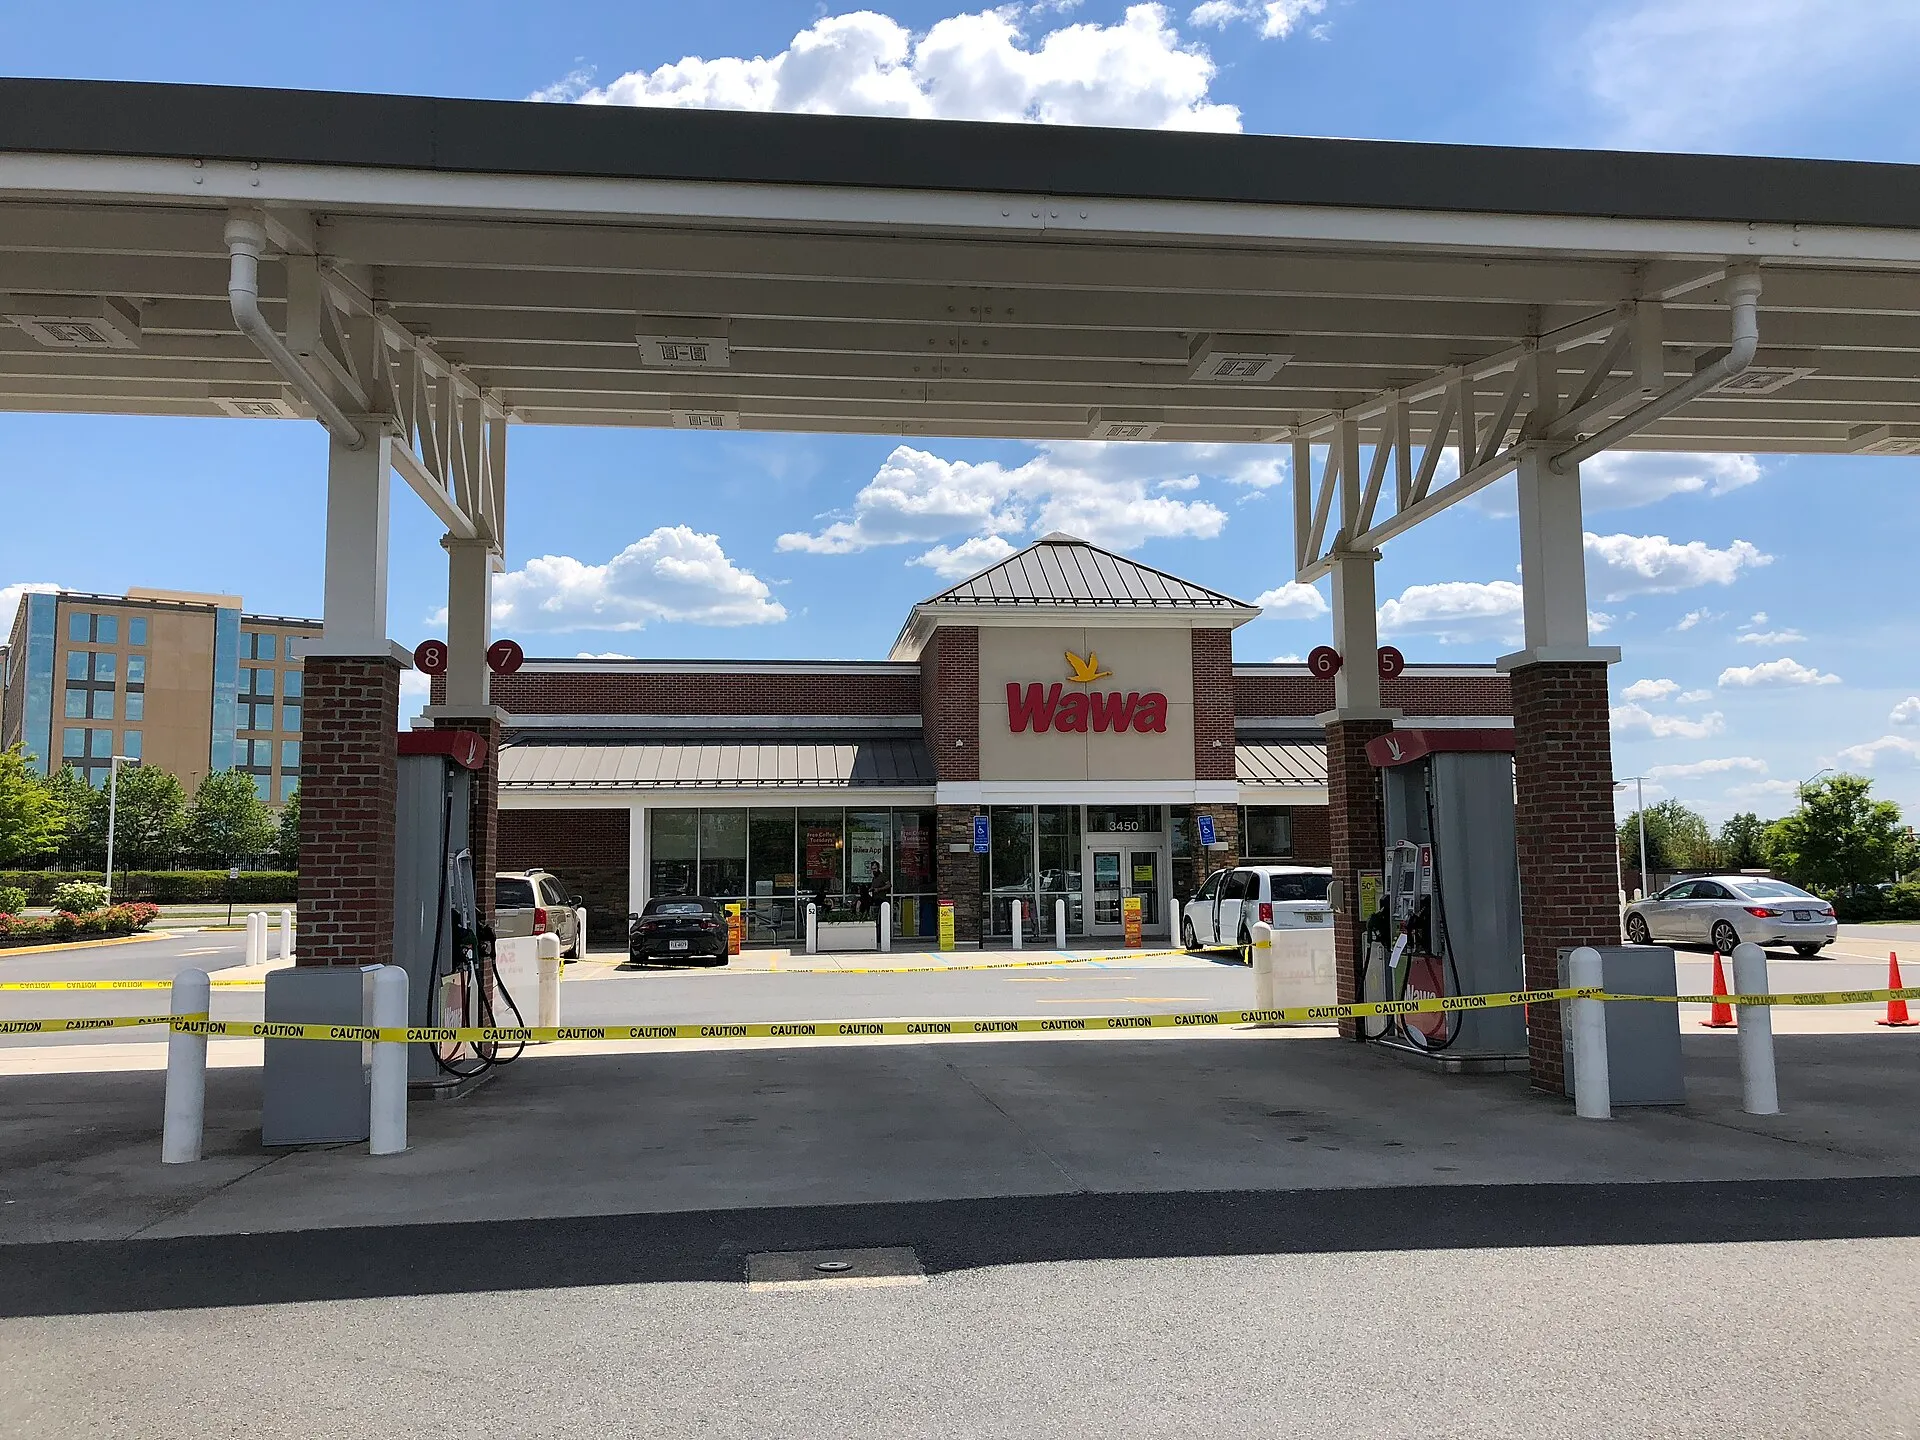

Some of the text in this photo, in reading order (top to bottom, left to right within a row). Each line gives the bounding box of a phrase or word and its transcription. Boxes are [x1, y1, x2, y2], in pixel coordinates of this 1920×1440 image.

[425, 648, 439, 667] 8
[498, 648, 512, 667] 7
[1317, 653, 1331, 672] 6
[1382, 654, 1394, 672] 5
[1005, 681, 1168, 734] Wawa
[1109, 821, 1139, 831] 3450
[1423, 852, 1429, 862] 6
[175, 1022, 226, 1033] CAUTION
[253, 1024, 304, 1037] CAUTION
[330, 1027, 380, 1040] CAUTION
[406, 1029, 457, 1040] CAUTION
[482, 1029, 532, 1040] CAUTION
[557, 1028, 605, 1039] CAUTION
[629, 1027, 676, 1038] CAUTION
[700, 1026, 747, 1037] CAUTION
[770, 1025, 816, 1036] CAUTION
[839, 1024, 884, 1035] CAUTION
[907, 1023, 951, 1033] CAUTION
[974, 1021, 1018, 1032] CAUTION
[1041, 1020, 1085, 1030] CAUTION
[1108, 1017, 1152, 1028] CAUTION
[1174, 1014, 1219, 1026] CAUTION
[1241, 1010, 1285, 1022] CAUTION
[1308, 1006, 1352, 1018] CAUTION
[1374, 1001, 1419, 1013] CAUTION
[1441, 996, 1486, 1009] CAUTION
[1509, 991, 1554, 1002] CAUTION
